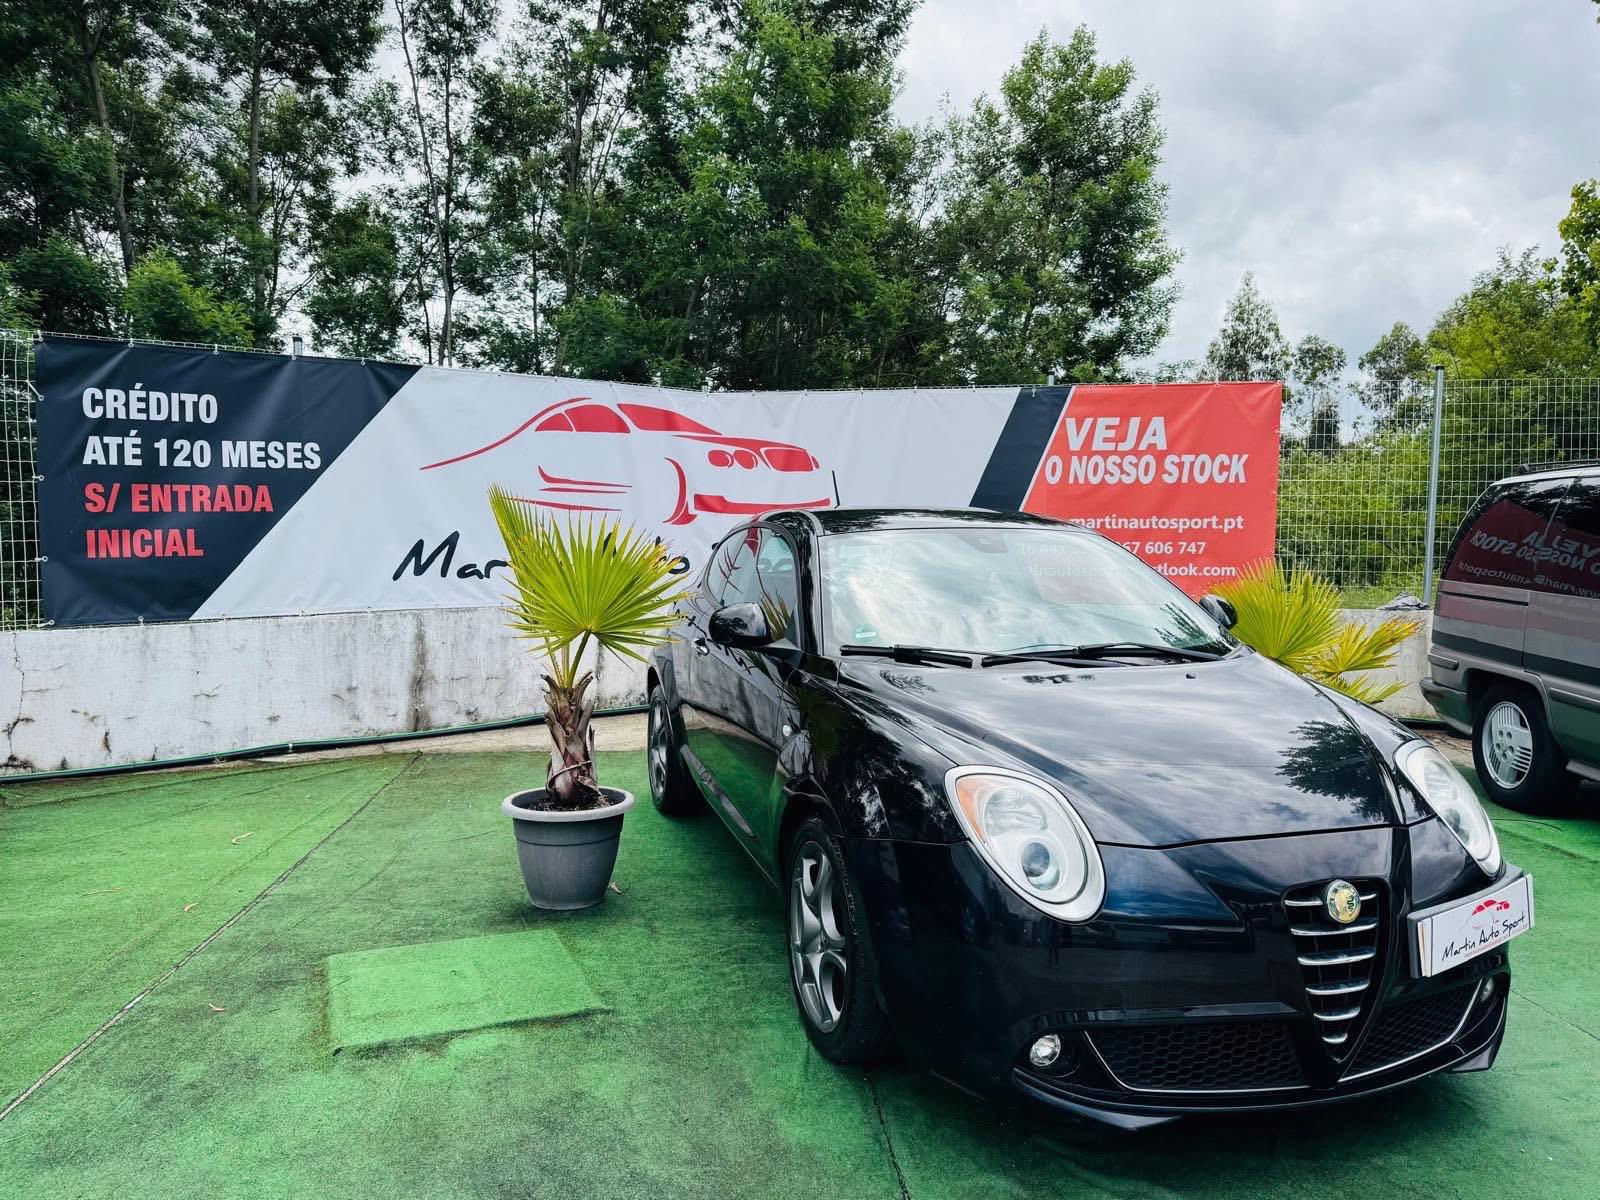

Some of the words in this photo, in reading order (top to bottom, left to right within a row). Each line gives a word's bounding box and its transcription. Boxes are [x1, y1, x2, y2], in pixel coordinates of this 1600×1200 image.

[82, 383, 218, 423] CRÉDITO
[82, 430, 142, 466] ATÉ
[154, 438, 212, 468] 120
[221, 440, 321, 469] MESES
[1065, 416, 1168, 451] VEJA
[1045, 455, 1063, 484] O
[1068, 454, 1156, 484] NOSSO
[1162, 454, 1249, 484] STOCK
[84, 483, 120, 513] S/
[131, 484, 273, 513] ENTRADA
[86, 529, 204, 558] INICIAL
[1145, 541, 1173, 554] 606
[1178, 541, 1206, 554] 747
[1442, 937, 1476, 962] Martin
[1479, 926, 1500, 946] Auto
[1502, 910, 1525, 936] Sport
